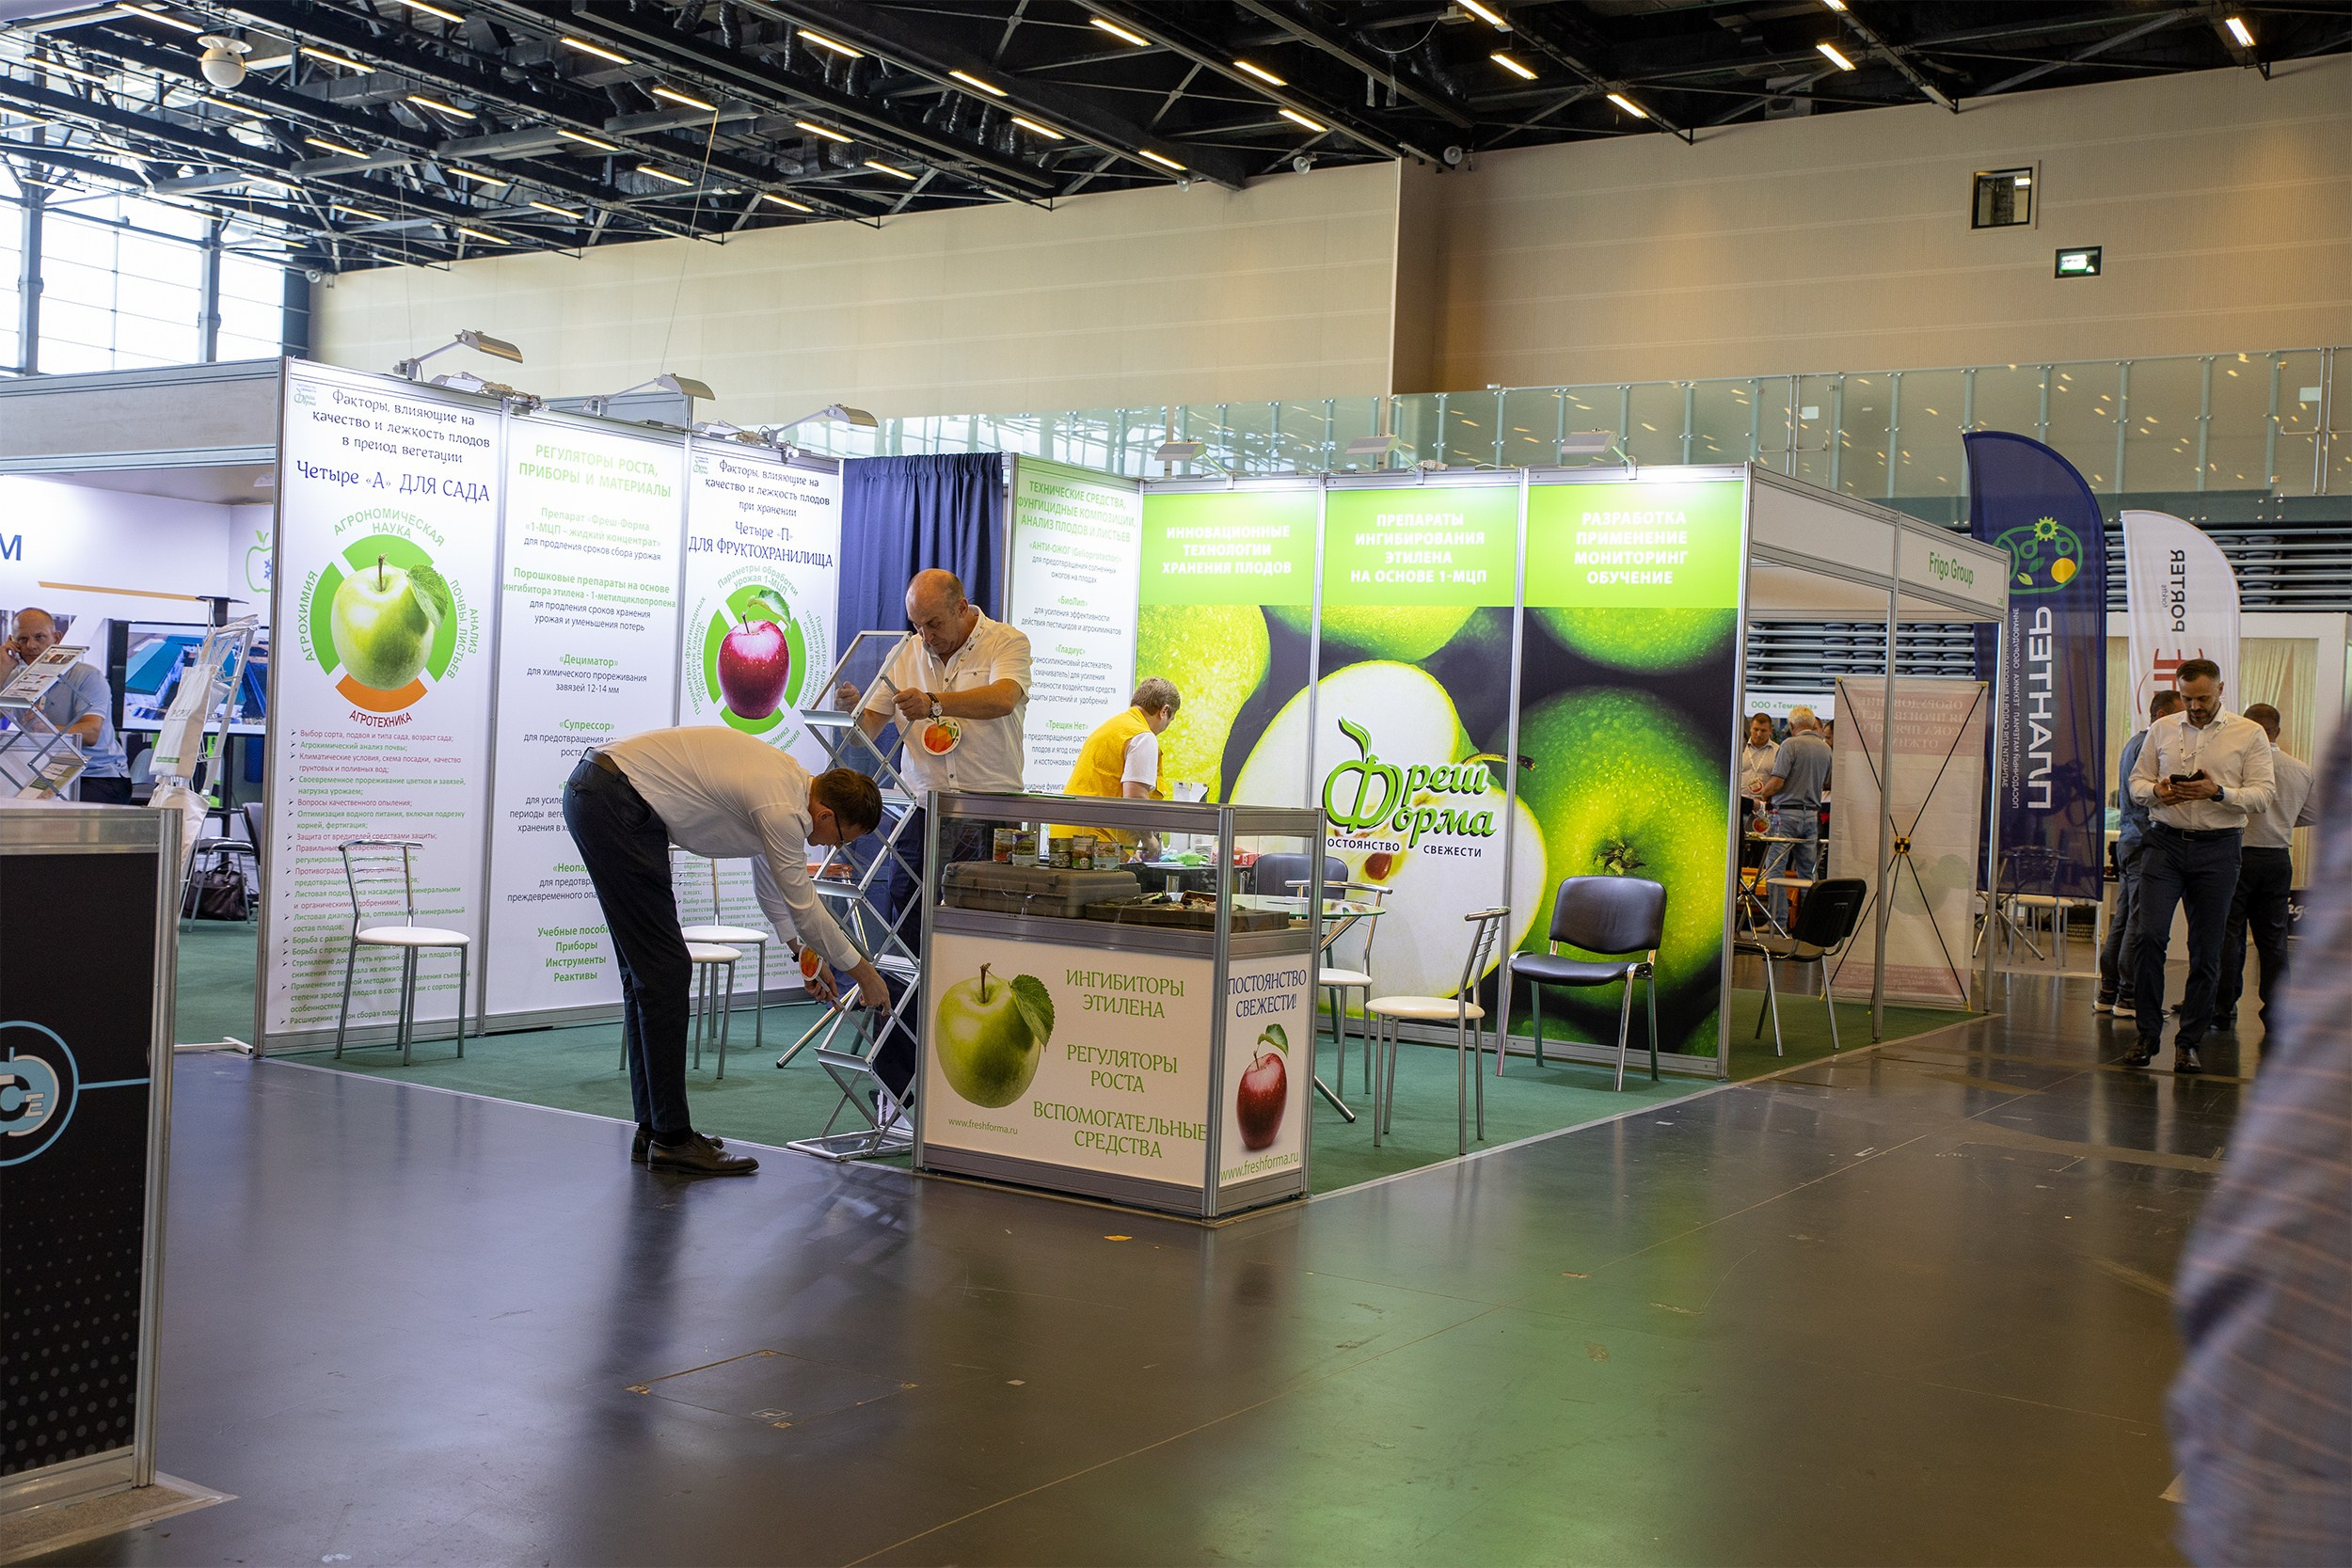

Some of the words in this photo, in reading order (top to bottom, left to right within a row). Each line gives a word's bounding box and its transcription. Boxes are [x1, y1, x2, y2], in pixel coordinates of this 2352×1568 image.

[333, 389, 389, 412] Факторы,
[395, 404, 457, 423] влияющие
[462, 416, 474, 425] на
[312, 411, 370, 428] качество
[374, 422, 382, 431] и
[388, 423, 444, 440] лежкость
[449, 434, 490, 448] плодов
[342, 436, 349, 446] в
[403, 446, 463, 464] вегетации
[535, 444, 613, 468] РЕГУЛЯТОРЫ
[619, 459, 659, 477] РОСТА,
[297, 461, 359, 486] Четыре
[366, 472, 391, 489] «А»
[400, 474, 437, 495] ДЛЯ
[442, 480, 489, 503] САДА
[519, 463, 580, 483] ПРИБОРЫ
[586, 474, 594, 485] И
[599, 476, 671, 498] МАТЕРИАЛЫ
[763, 470, 806, 486] влияющие
[809, 479, 818, 487] на
[706, 478, 745, 492] качество
[757, 486, 798, 500] лежкость
[800, 494, 830, 505] плодов
[1030, 482, 1084, 500] ТЕХНИЧЕСКИЕ
[1087, 492, 1126, 510] СРЕДСТВА,
[541, 507, 584, 522] Препарат
[739, 500, 754, 513] при
[757, 504, 797, 517] хранении
[1017, 497, 1078, 516] ФУНГИЦИДНЫЕ
[334, 508, 445, 546] АГРОНОМИЧЕСКАЯ
[1377, 513, 1464, 528] ПРЕПАРАТЫ
[1581, 512, 1686, 525] РАЗРАБОТКА
[373, 523, 411, 539] НАУКА
[526, 522, 561, 535] «1-МЦП
[569, 530, 604, 540] жидкий
[607, 535, 660, 547] концентрат»
[736, 521, 773, 540] Четыре
[1022, 515, 1054, 530] АНАЛИЗ
[1056, 521, 1088, 535] ПЛОДОВ
[1089, 527, 1095, 536] И
[1096, 529, 1130, 542] ЛИСТЬЕВ
[1166, 525, 1291, 540] ИННОВАЦИОННЫЕ
[1355, 531, 1485, 546] ИНГИБИРОВАНИЯ
[1576, 531, 1687, 546] ПРИМЕНЕНИЕ
[540, 540, 581, 551] продления
[583, 546, 610, 555] сроков
[612, 547, 632, 558] сбора
[634, 552, 660, 561] урожая
[689, 536, 713, 553] ДЛЯ
[717, 538, 833, 569] ФРУКТОХРАНИЛИЩА
[1183, 543, 1272, 557] ТЕХНОЛОГИИ
[1385, 550, 1453, 564] ЭТИЛЕНА
[1574, 550, 1688, 564] МОНИТОРИНГ
[1162, 561, 1232, 575] ХРАНЕНИЯ
[1234, 561, 1292, 576] ПЛОДОВ
[1351, 571, 1371, 583] НА
[1375, 570, 1435, 583] ОСНОВЕ
[1439, 570, 1487, 585] 1-МЦП
[1587, 571, 1673, 585] ОБУЧЕНИЕ
[1929, 551, 1949, 580] Frigo
[1951, 559, 1974, 589] Group
[514, 567, 575, 583] Порошковые
[577, 578, 626, 590] препараты
[628, 581, 638, 590] на
[640, 583, 670, 594] основе
[503, 584, 551, 595] ингибитора
[553, 589, 584, 598] этилена
[591, 592, 675, 608] 1-метилциклопропена
[298, 571, 318, 661] АГРОХИМИЯ
[530, 600, 543, 609] для
[546, 602, 587, 613] продления
[588, 606, 614, 616] сроков
[468, 609, 479, 655] АНАЛИЗ
[534, 615, 563, 625] урожая
[572, 619, 618, 628] уменьшения
[620, 623, 645, 632] потерь
[446, 627, 467, 679] ЛИСТЬЕВ
[559, 654, 618, 667] «Дециматор»
[527, 667, 541, 676] для
[543, 670, 591, 678] химического
[593, 673, 647, 682] прореживания
[556, 683, 585, 691] завязей
[349, 710, 412, 728] АГРОТЕХНИКА
[559, 720, 614, 732] «Супрессор»
[524, 734, 538, 742] для
[540, 736, 604, 744] предотвращения
[561, 749, 581, 757] роста
[1322, 753, 1488, 834] Фреш
[510, 810, 544, 818] периоды
[1327, 838, 1400, 852] ОСТОЯНСТВО
[1423, 845, 1482, 858] СВЕЖЕСТИ
[507, 891, 582, 902] преждевременного
[538, 927, 578, 937] Учебные
[555, 941, 597, 952] Приборы
[546, 956, 606, 967] Инструменты
[553, 972, 596, 982] Реактивы
[1066, 969, 1184, 997] ИНГИБИТОРЫ
[1227, 969, 1307, 995] ПОСТОЯНСТВО
[1082, 994, 1165, 1019] ЭТИЛЕНА
[1235, 993, 1297, 1018] СВЕЖЕСТИ!
[1067, 1043, 1178, 1074] РЕГУЛЯТОРЫ
[1091, 1070, 1145, 1093] РОСТА
[947, 1117, 1018, 1135] www.freshforma.ru
[1033, 1101, 1207, 1143] ВСПОМОГАТЕЛЬНЫЕ
[1073, 1131, 1162, 1159] СРЕДСТВА
[1220, 1150, 1300, 1181] www.freshforma.ru
